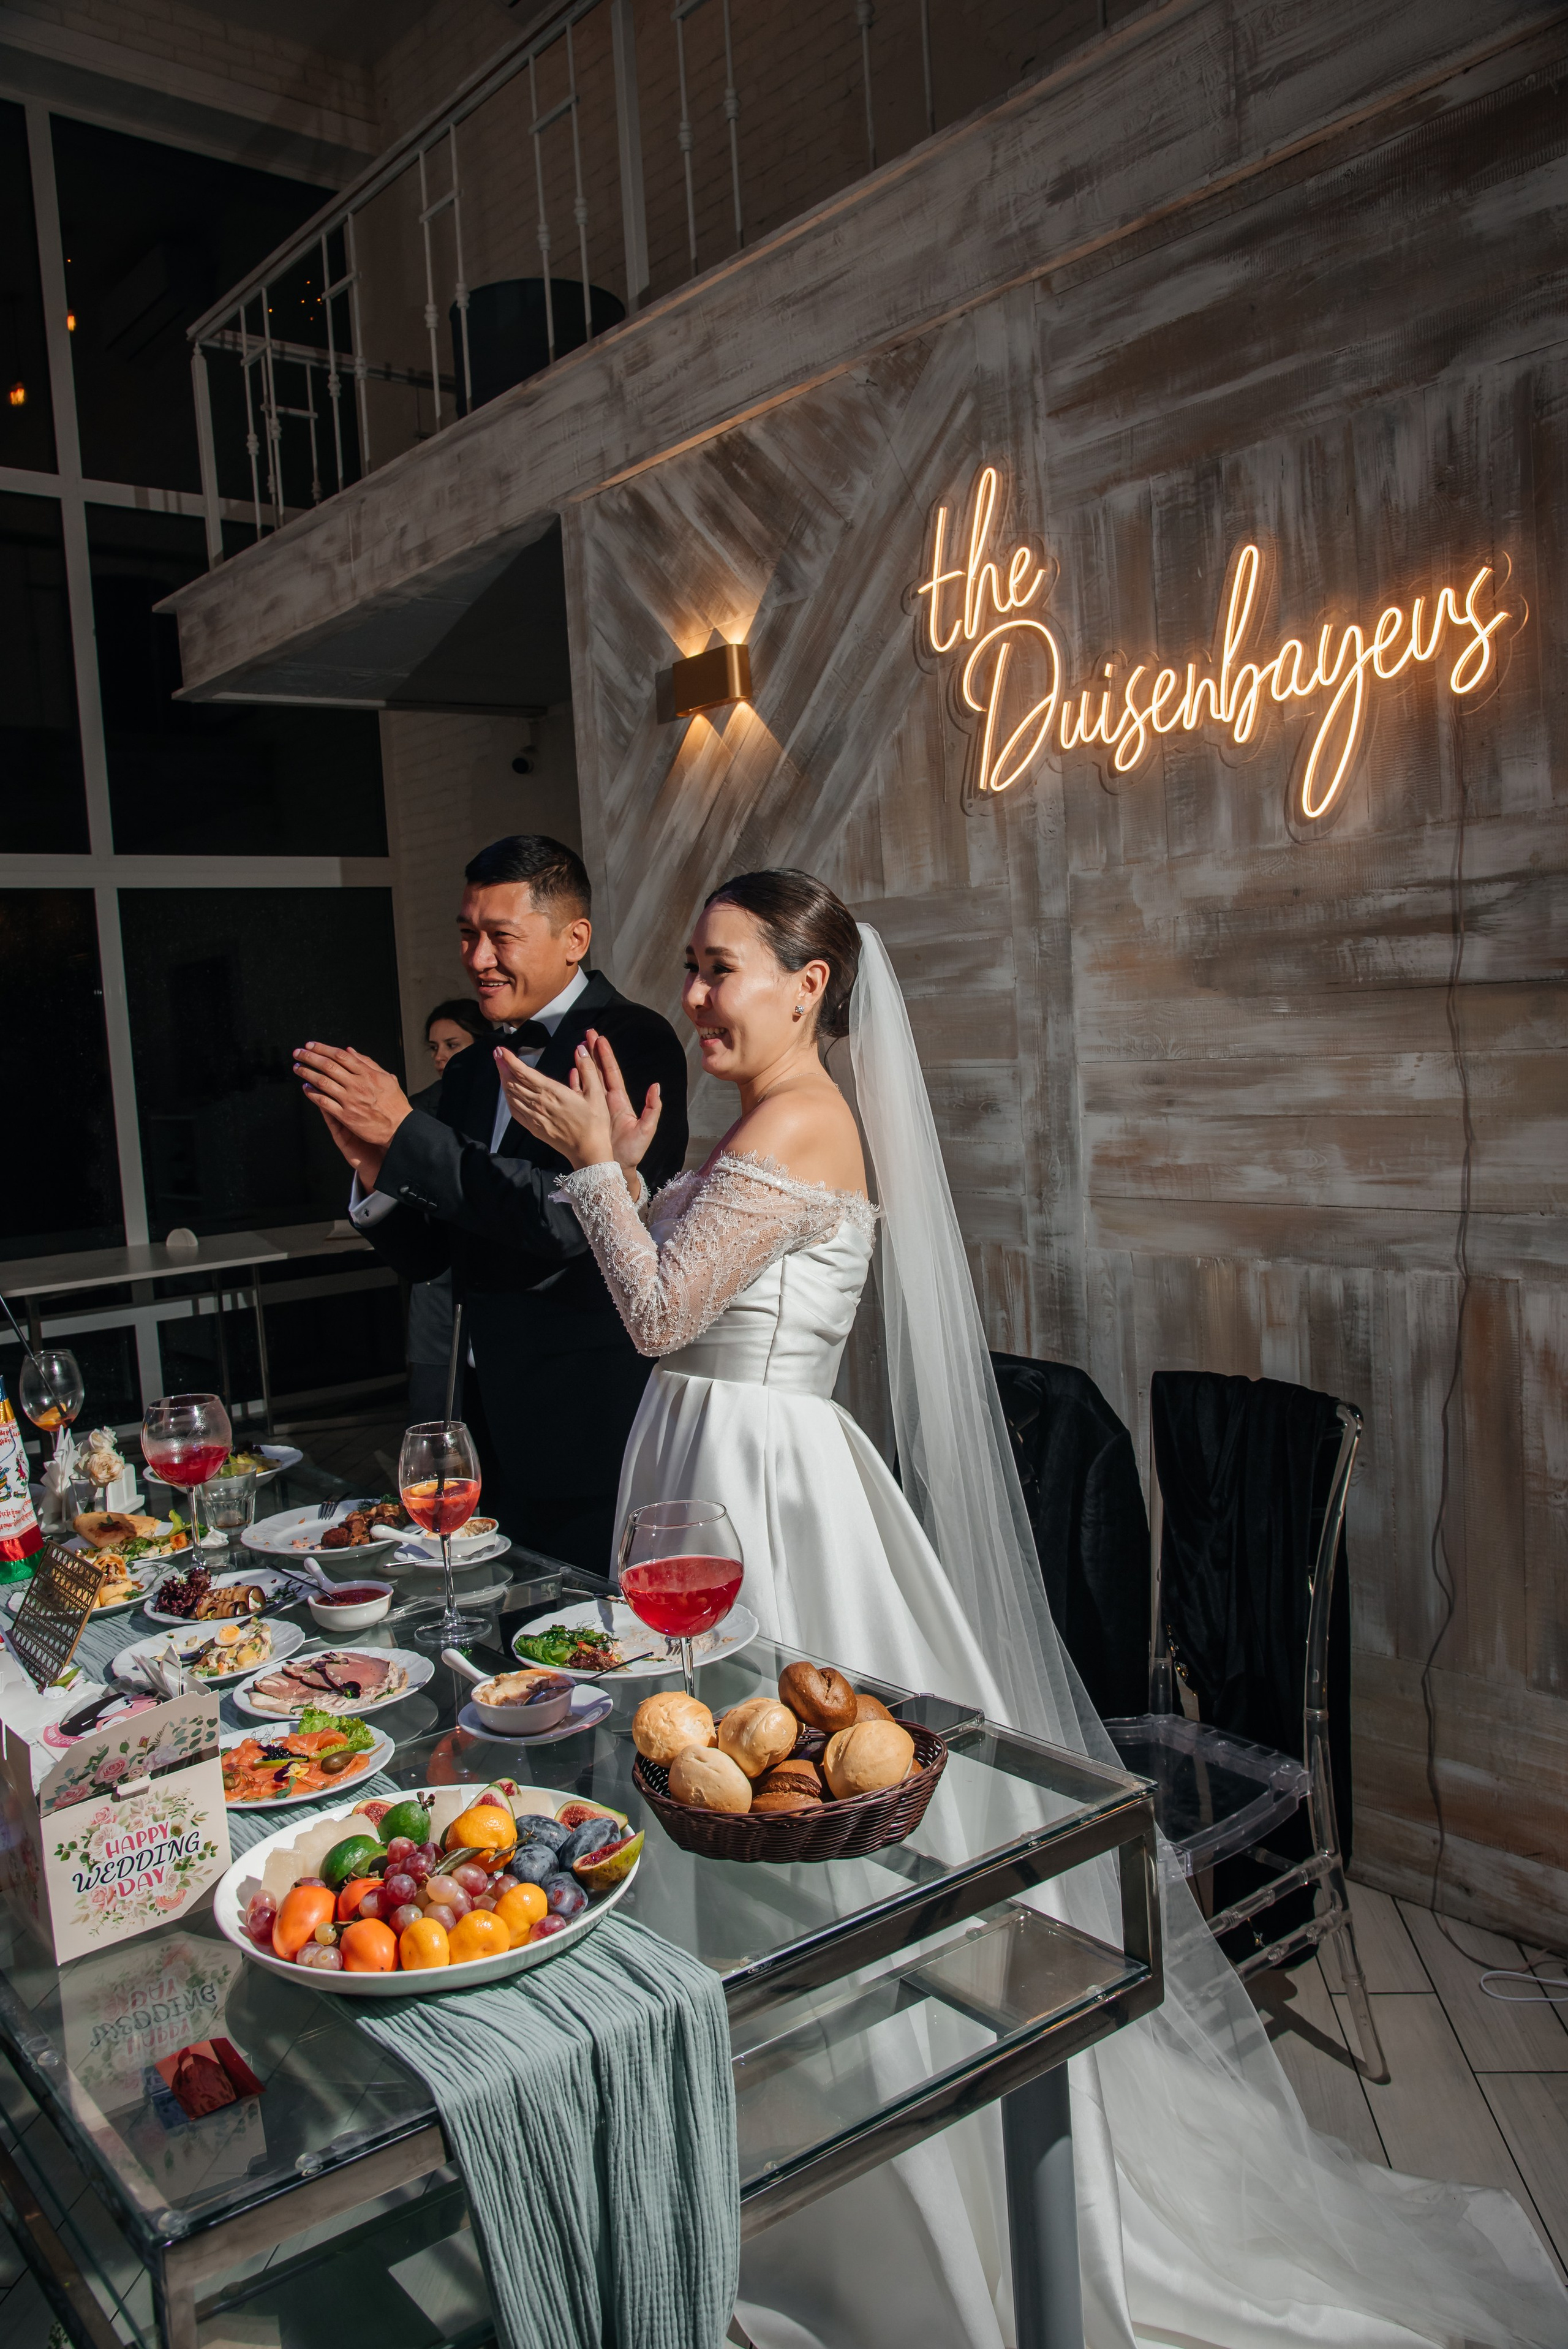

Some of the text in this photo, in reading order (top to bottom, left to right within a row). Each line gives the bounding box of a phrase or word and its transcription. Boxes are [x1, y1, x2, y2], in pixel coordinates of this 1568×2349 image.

[918, 467, 1046, 652] the
[72, 1831, 200, 1893] WEDDING
[105, 1822, 168, 1858] HAPPY
[117, 1866, 164, 1897] DAY
